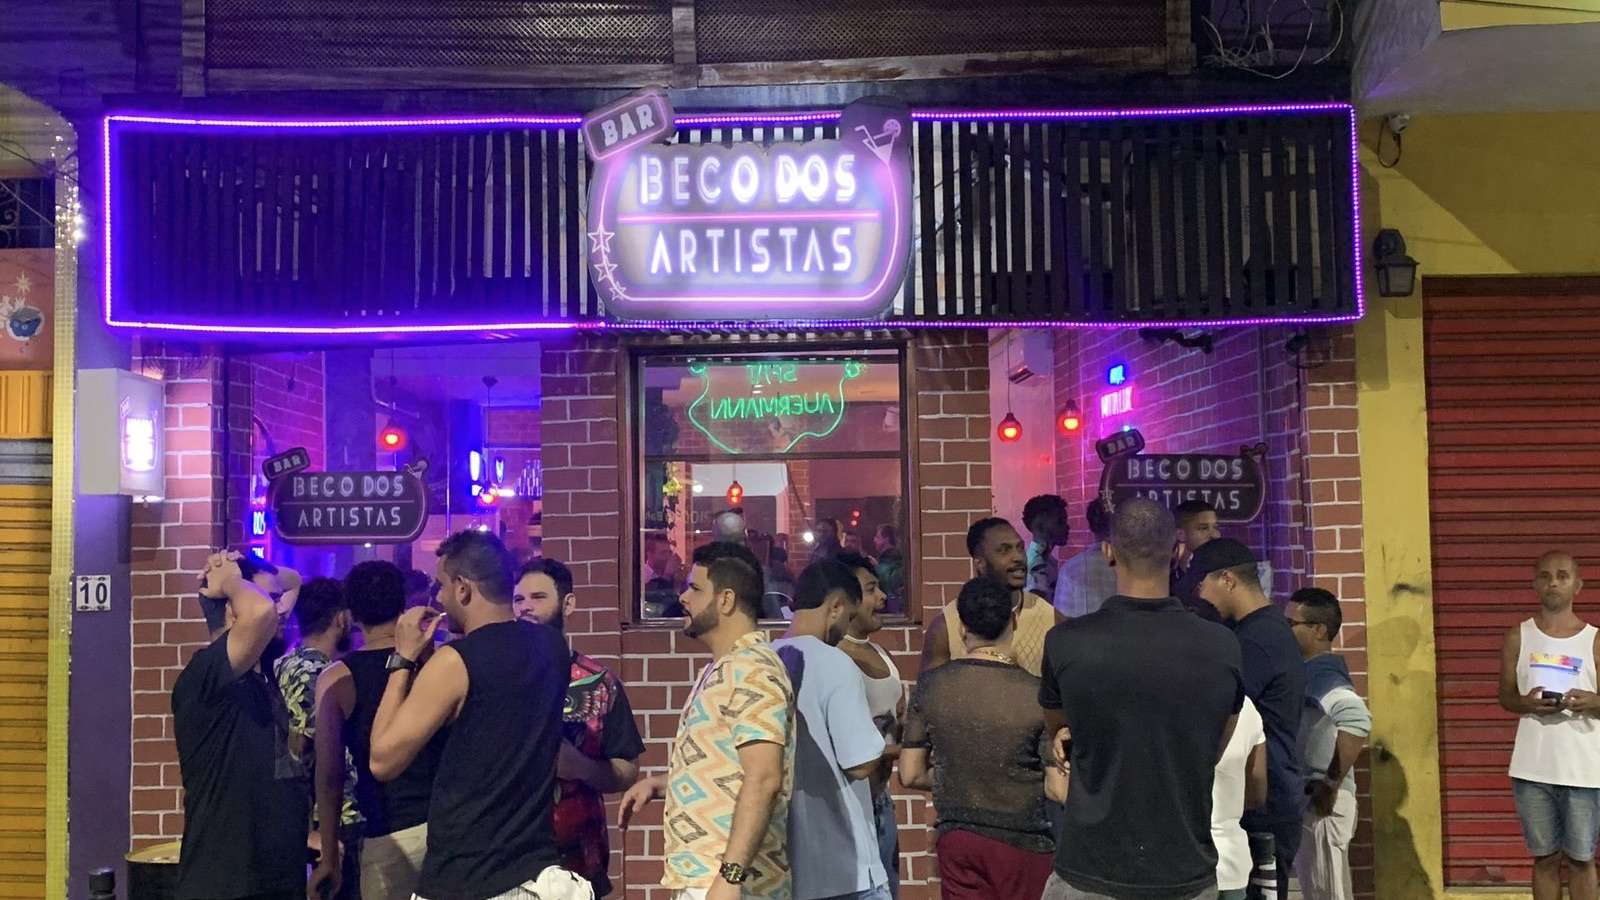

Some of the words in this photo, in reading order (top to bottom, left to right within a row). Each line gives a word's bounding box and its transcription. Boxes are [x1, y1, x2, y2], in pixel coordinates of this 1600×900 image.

[601, 103, 655, 147] BAR
[640, 154, 759, 204] BECO
[775, 153, 856, 203] DOS
[650, 227, 852, 274] ARTISTAS
[1107, 437, 1136, 454] BAR
[273, 455, 301, 472] BAR
[1128, 458, 1191, 480] BECO
[1200, 458, 1243, 480] DOS
[293, 476, 354, 498] BECO
[363, 475, 404, 497] DOS
[298, 507, 401, 527] ARTISTAS
[80, 582, 107, 604] 10
